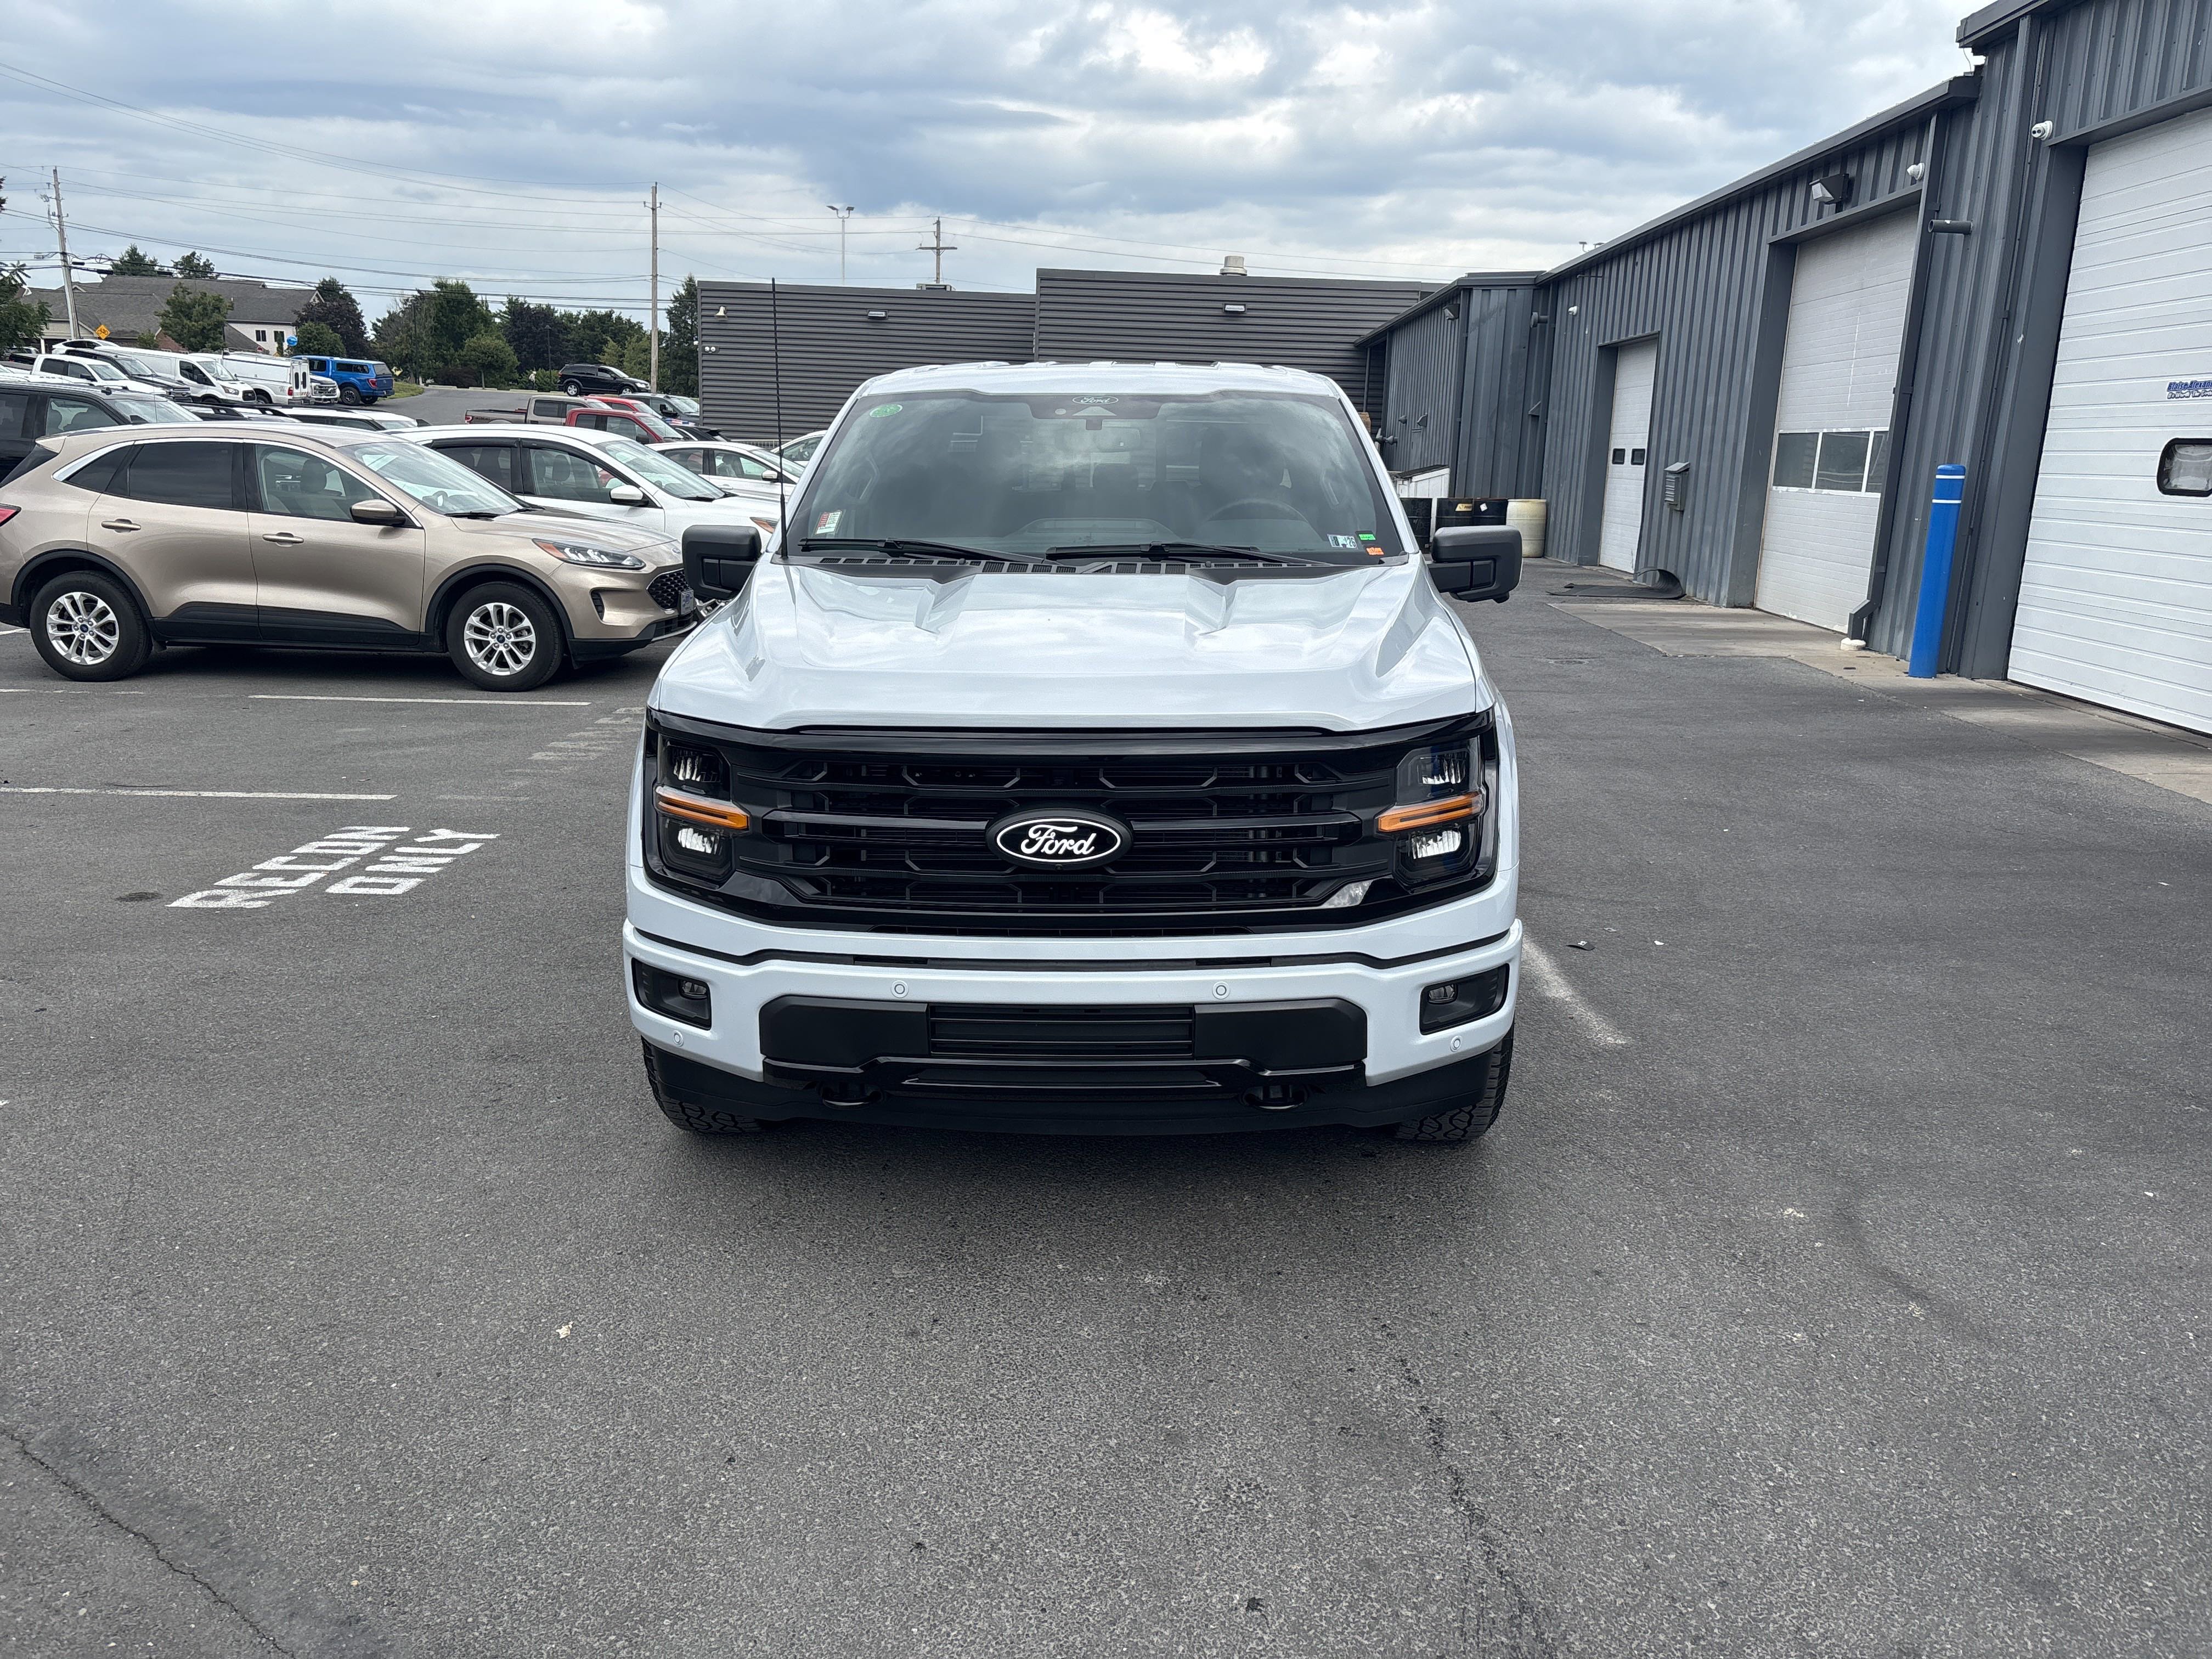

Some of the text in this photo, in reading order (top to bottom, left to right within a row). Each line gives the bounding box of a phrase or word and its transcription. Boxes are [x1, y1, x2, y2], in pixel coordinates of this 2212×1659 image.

[2167, 380, 2212, 391] Blaise Alexan
[1347, 537, 1356, 547] 26
[1020, 824, 1097, 855] Ford
[165, 826, 411, 908] RECON
[325, 828, 500, 894] ONLY
